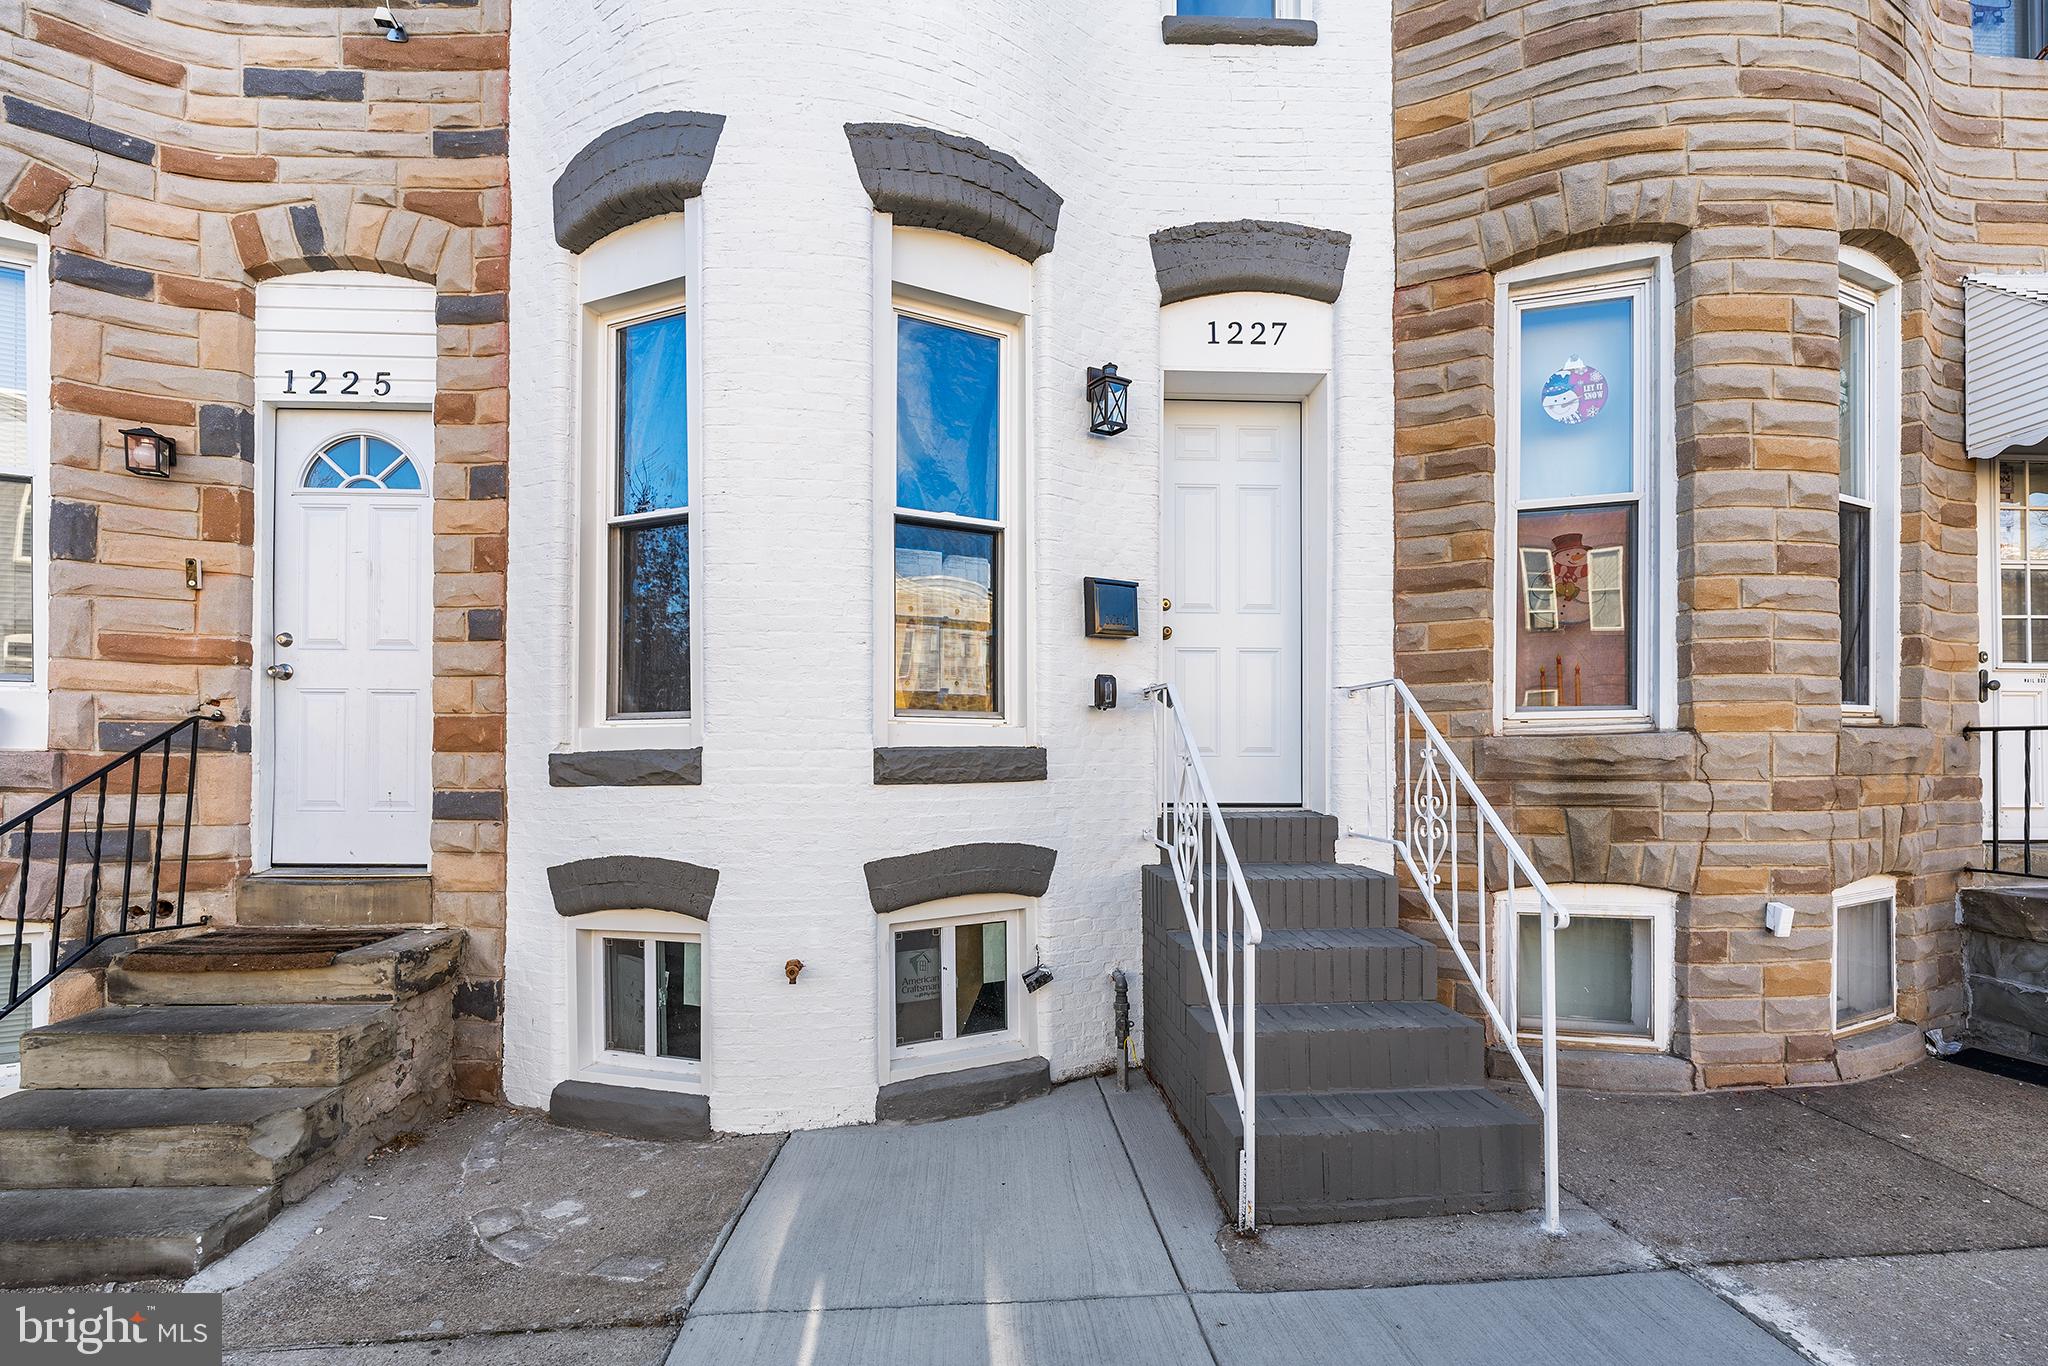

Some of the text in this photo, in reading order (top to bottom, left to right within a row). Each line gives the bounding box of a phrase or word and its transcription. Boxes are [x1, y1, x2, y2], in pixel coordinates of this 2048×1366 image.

[1207, 320, 1288, 346] 1227
[282, 369, 392, 397] 1225
[1583, 382, 1604, 392] LET IT
[1583, 390, 1604, 400] SNOW
[902, 975, 940, 986] American
[901, 983, 940, 994] Craftsman
